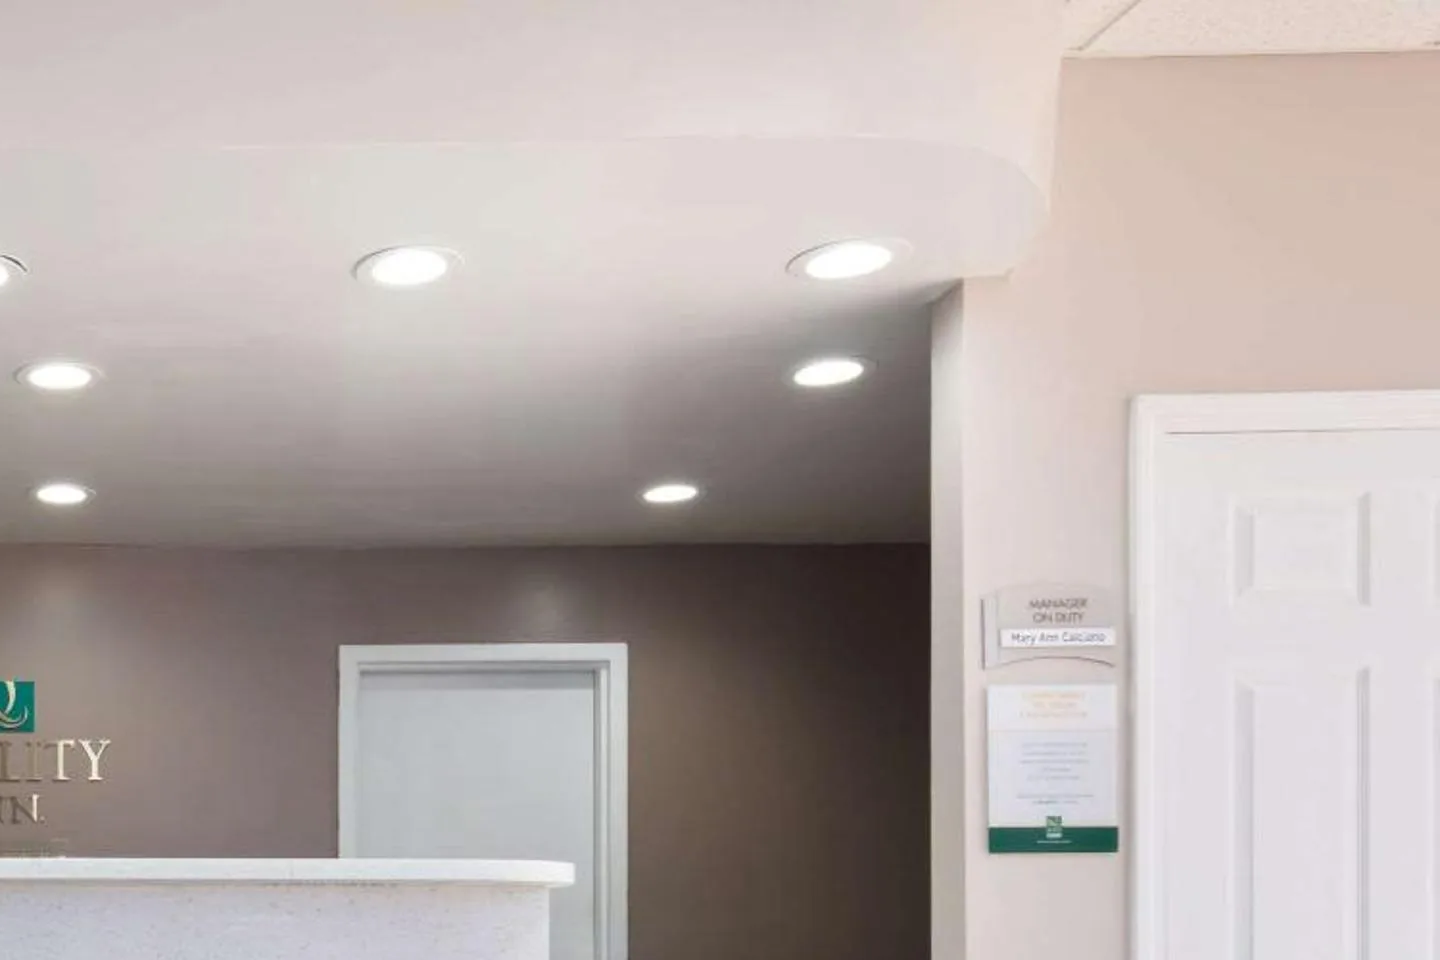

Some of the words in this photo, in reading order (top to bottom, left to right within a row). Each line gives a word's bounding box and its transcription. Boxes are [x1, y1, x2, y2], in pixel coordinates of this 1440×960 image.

[1029, 598, 1088, 610] MANAGER
[1032, 612, 1053, 623] ON
[1055, 612, 1085, 623] DUTY
[1011, 631, 1037, 645] Mary
